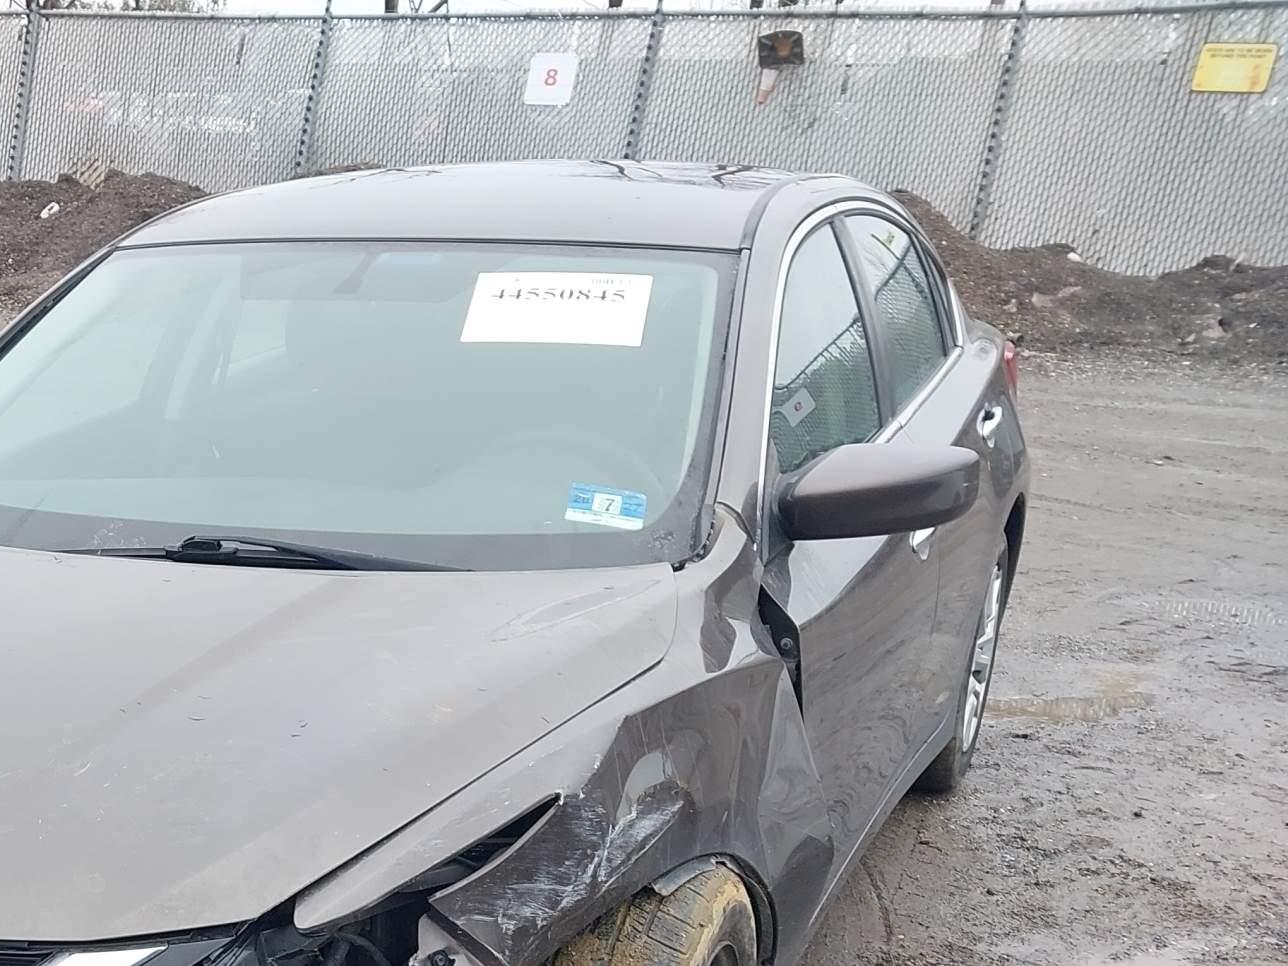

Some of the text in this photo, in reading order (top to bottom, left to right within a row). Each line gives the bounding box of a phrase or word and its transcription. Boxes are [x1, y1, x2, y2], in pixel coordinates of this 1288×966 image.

[544, 69, 558, 86] 8
[491, 287, 626, 303] 44550845
[605, 498, 615, 511] 7
